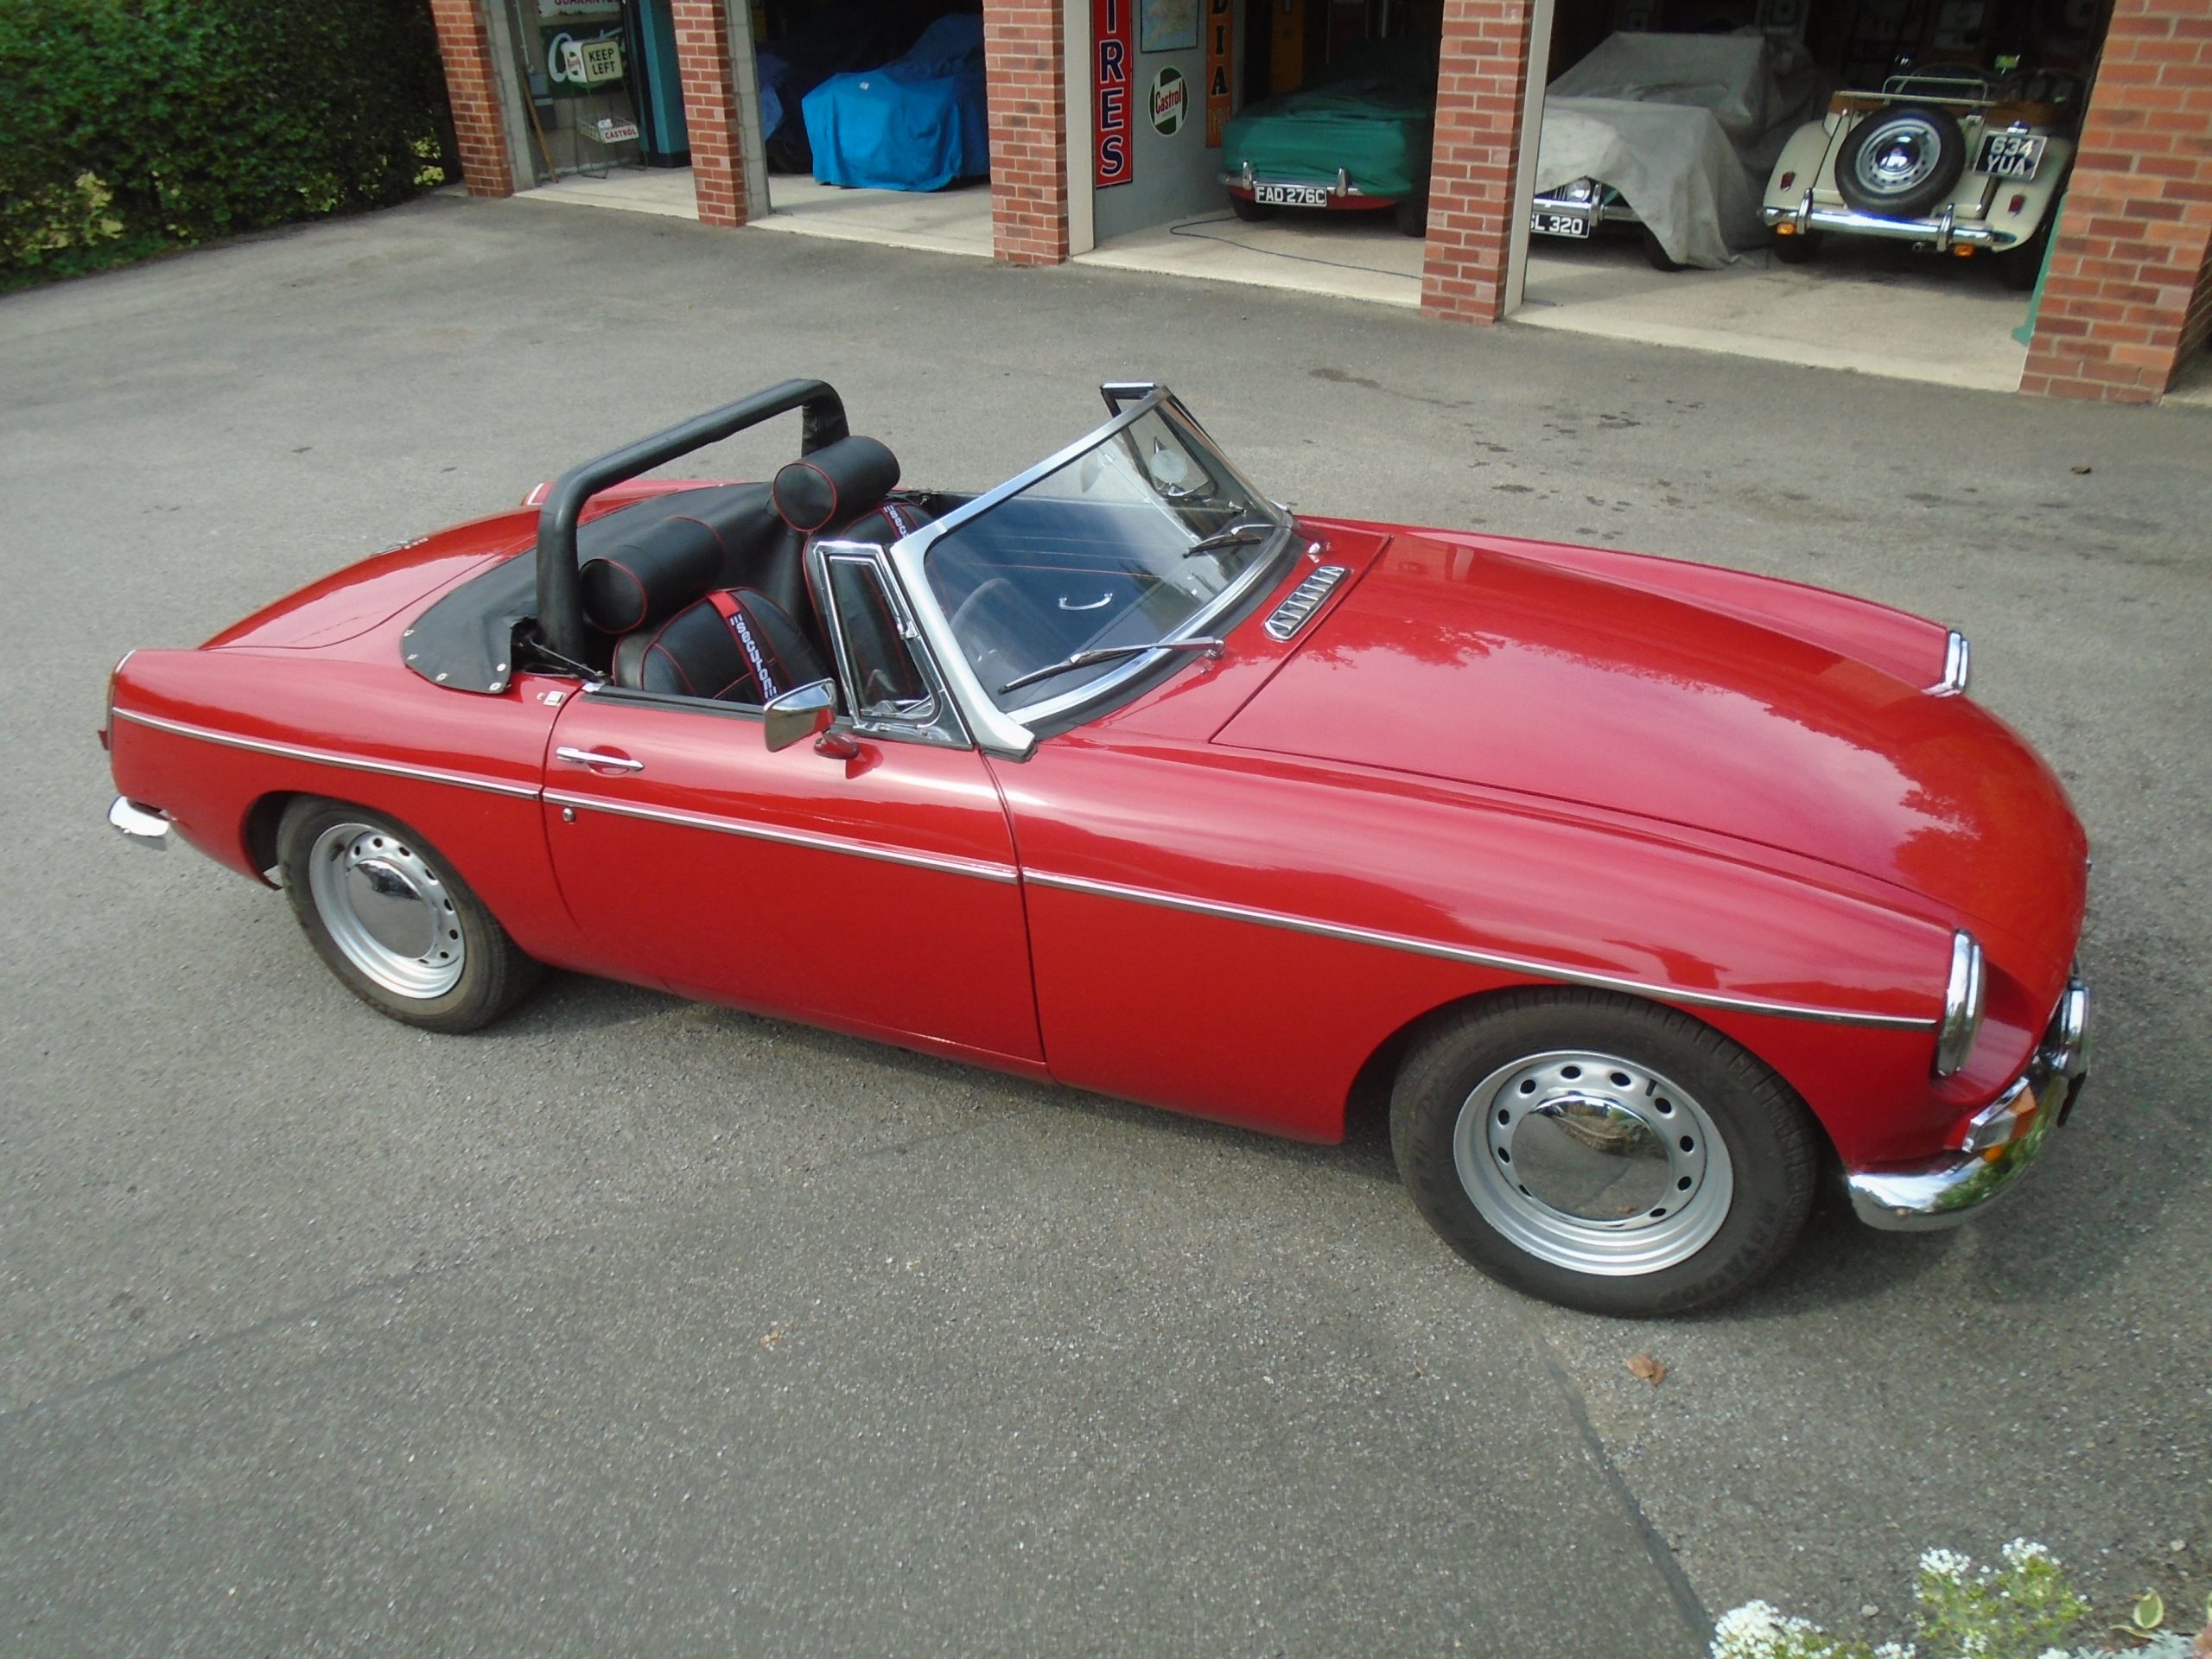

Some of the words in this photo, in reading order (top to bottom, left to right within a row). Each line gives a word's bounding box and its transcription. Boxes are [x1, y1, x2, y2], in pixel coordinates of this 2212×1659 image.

[588, 48, 614, 62] KEEP
[591, 61, 615, 75] LEFT
[1155, 82, 1182, 114] Castrol
[605, 128, 636, 139] CASTROL
[1991, 137, 2034, 157] 634
[1986, 155, 2025, 178] YUA
[1256, 187, 1284, 202] FAD
[1287, 188, 1325, 204] 276C
[1549, 216, 1583, 235] 320
